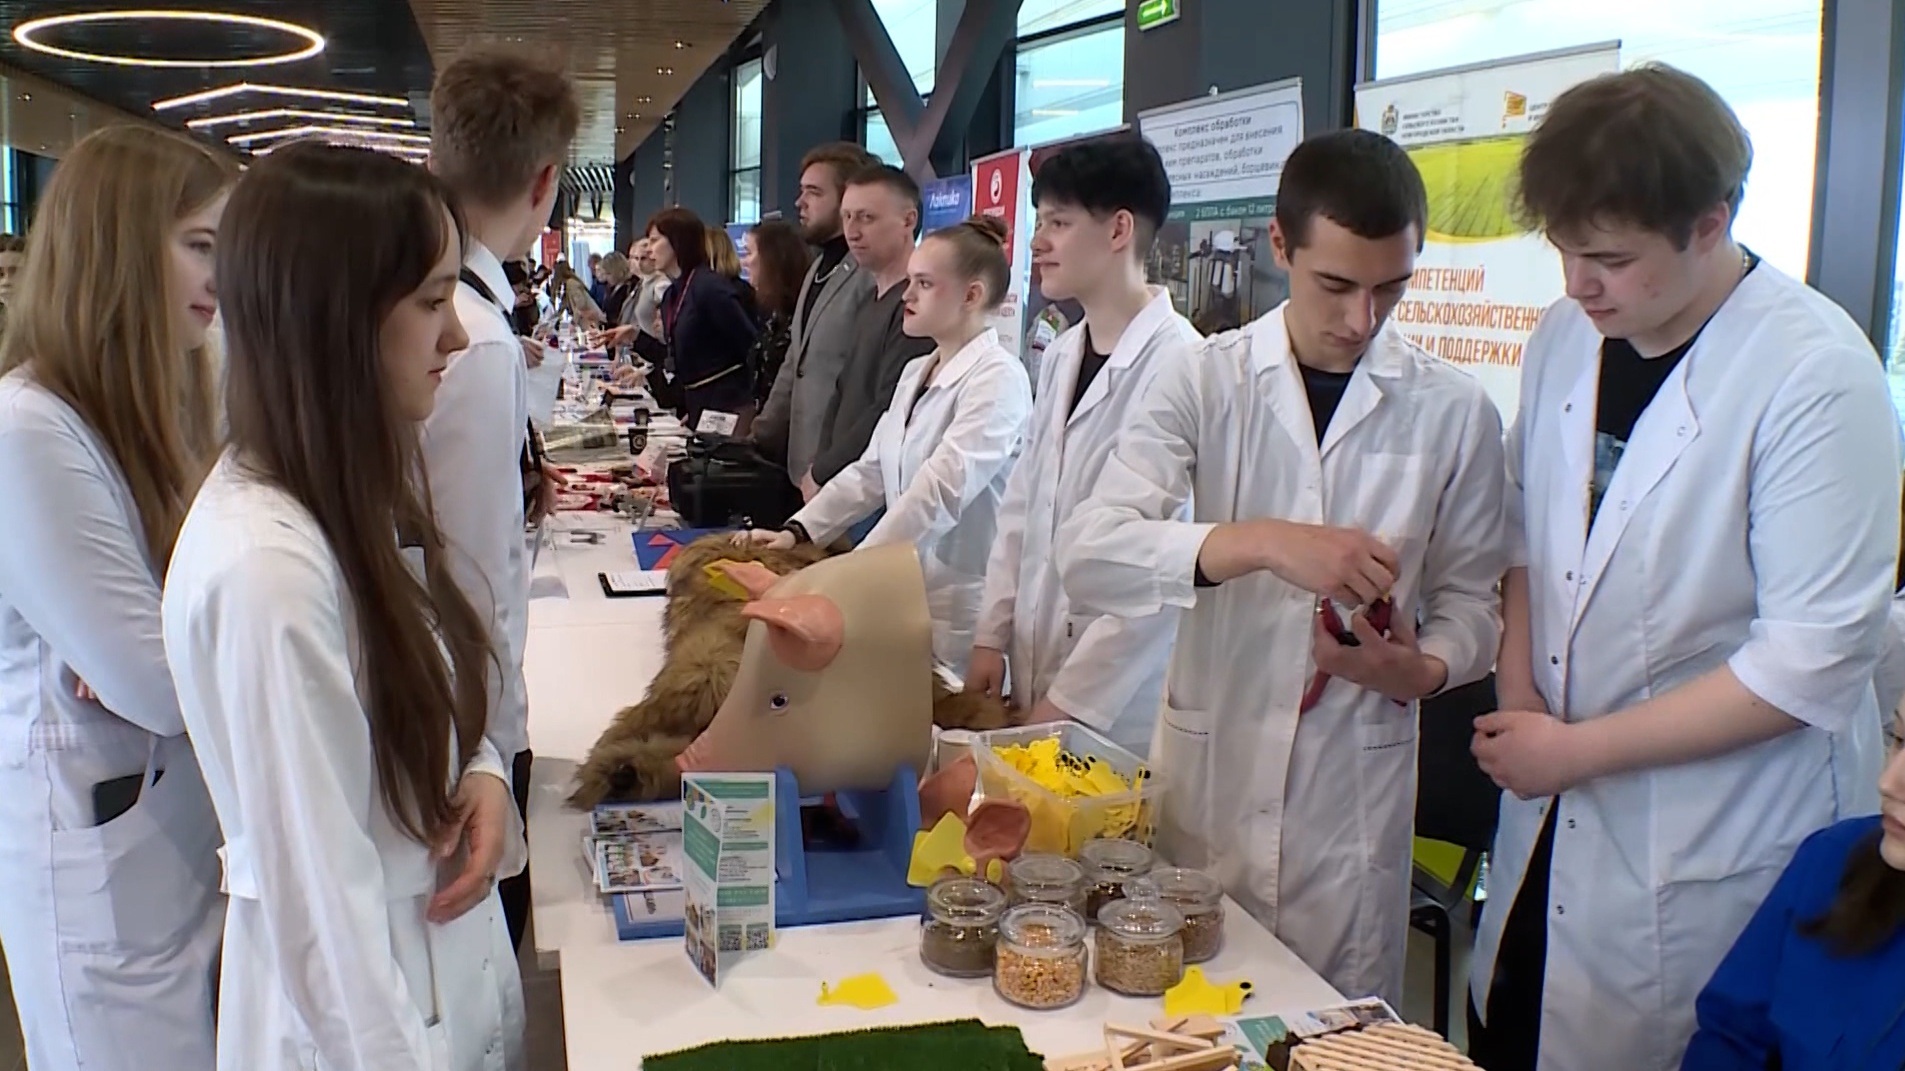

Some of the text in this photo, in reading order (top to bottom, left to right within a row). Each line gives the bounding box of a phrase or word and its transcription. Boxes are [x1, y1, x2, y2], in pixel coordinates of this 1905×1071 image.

[1156, 125, 1283, 154] плекс предназначен для внесения
[1174, 116, 1252, 138] Комплекс обработки
[1224, 146, 1263, 160] обработки
[1438, 335, 1524, 368] ПОДДЕРЖКИ
